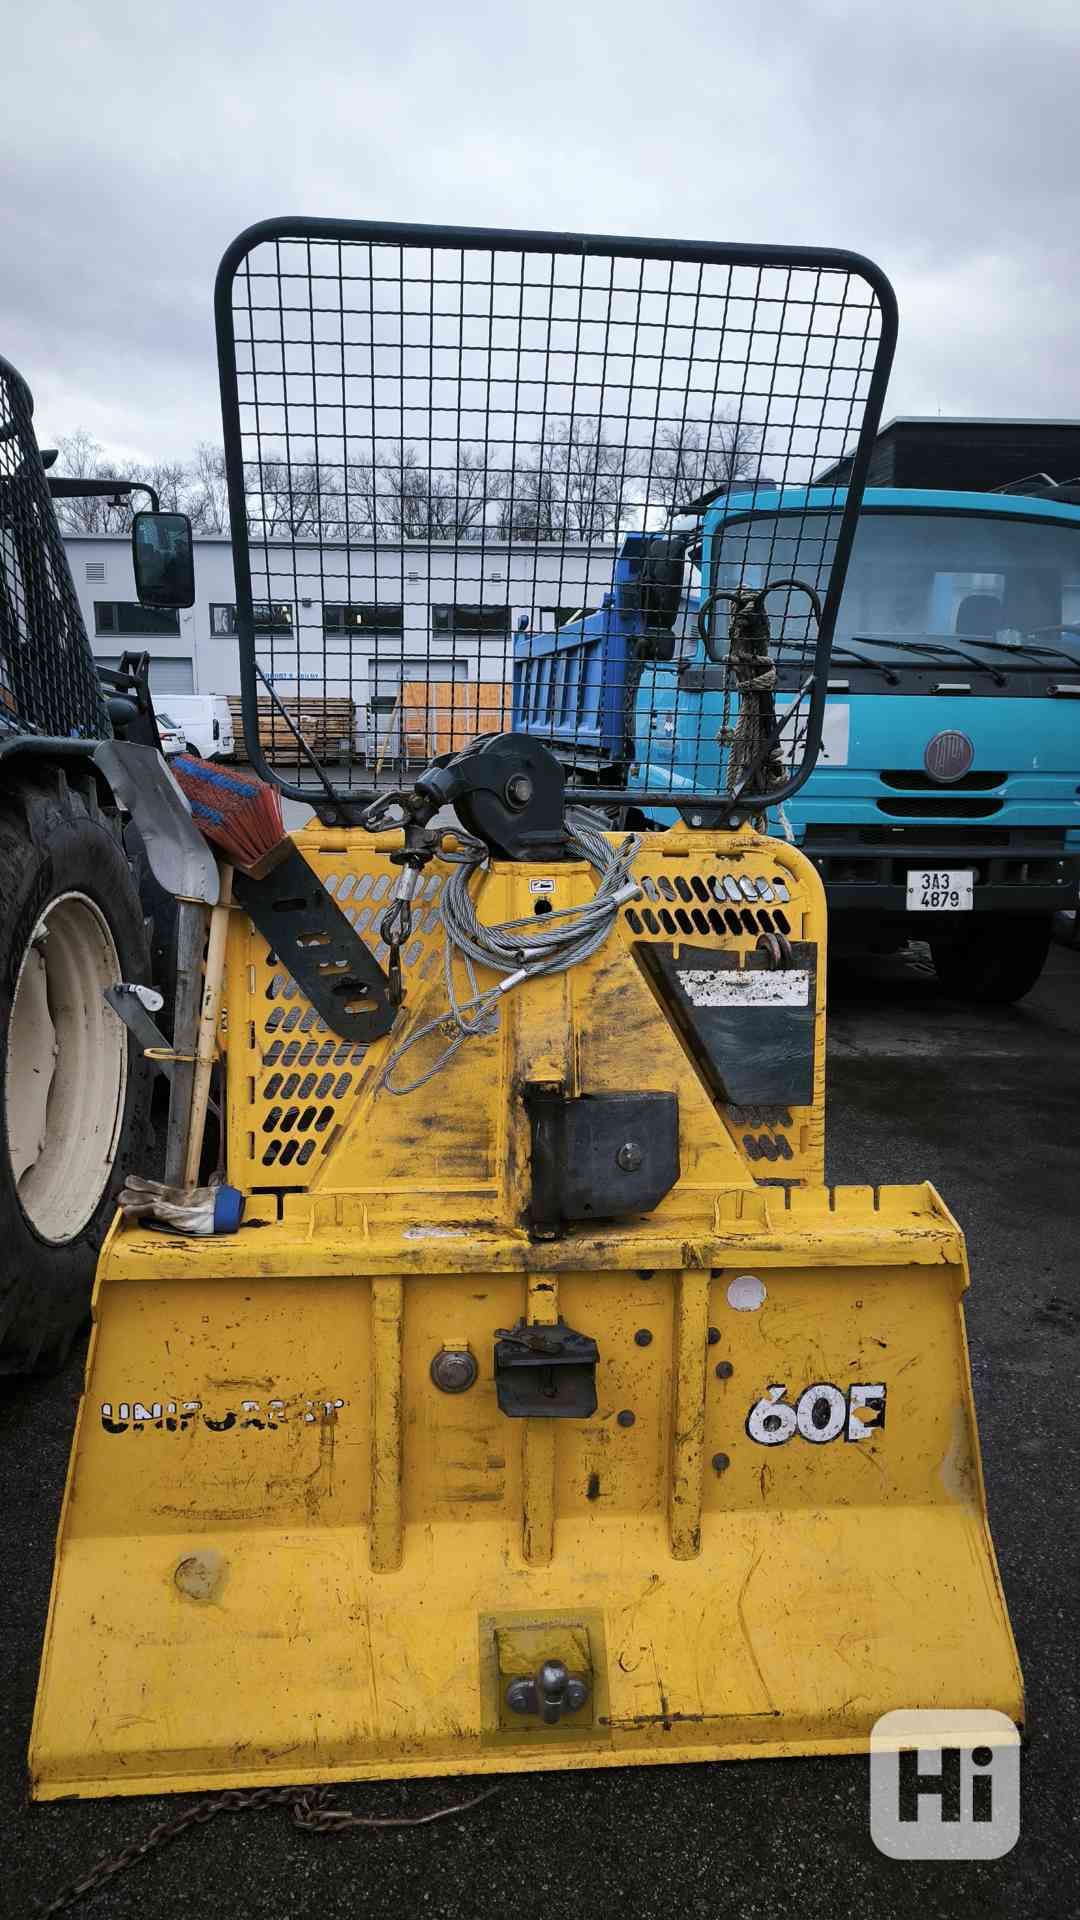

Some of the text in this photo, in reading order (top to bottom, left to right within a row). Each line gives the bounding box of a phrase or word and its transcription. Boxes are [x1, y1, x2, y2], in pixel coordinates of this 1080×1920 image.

[921, 872, 950, 889] 3A3
[920, 890, 960, 908] 4879
[745, 1383, 887, 1446] 60E
